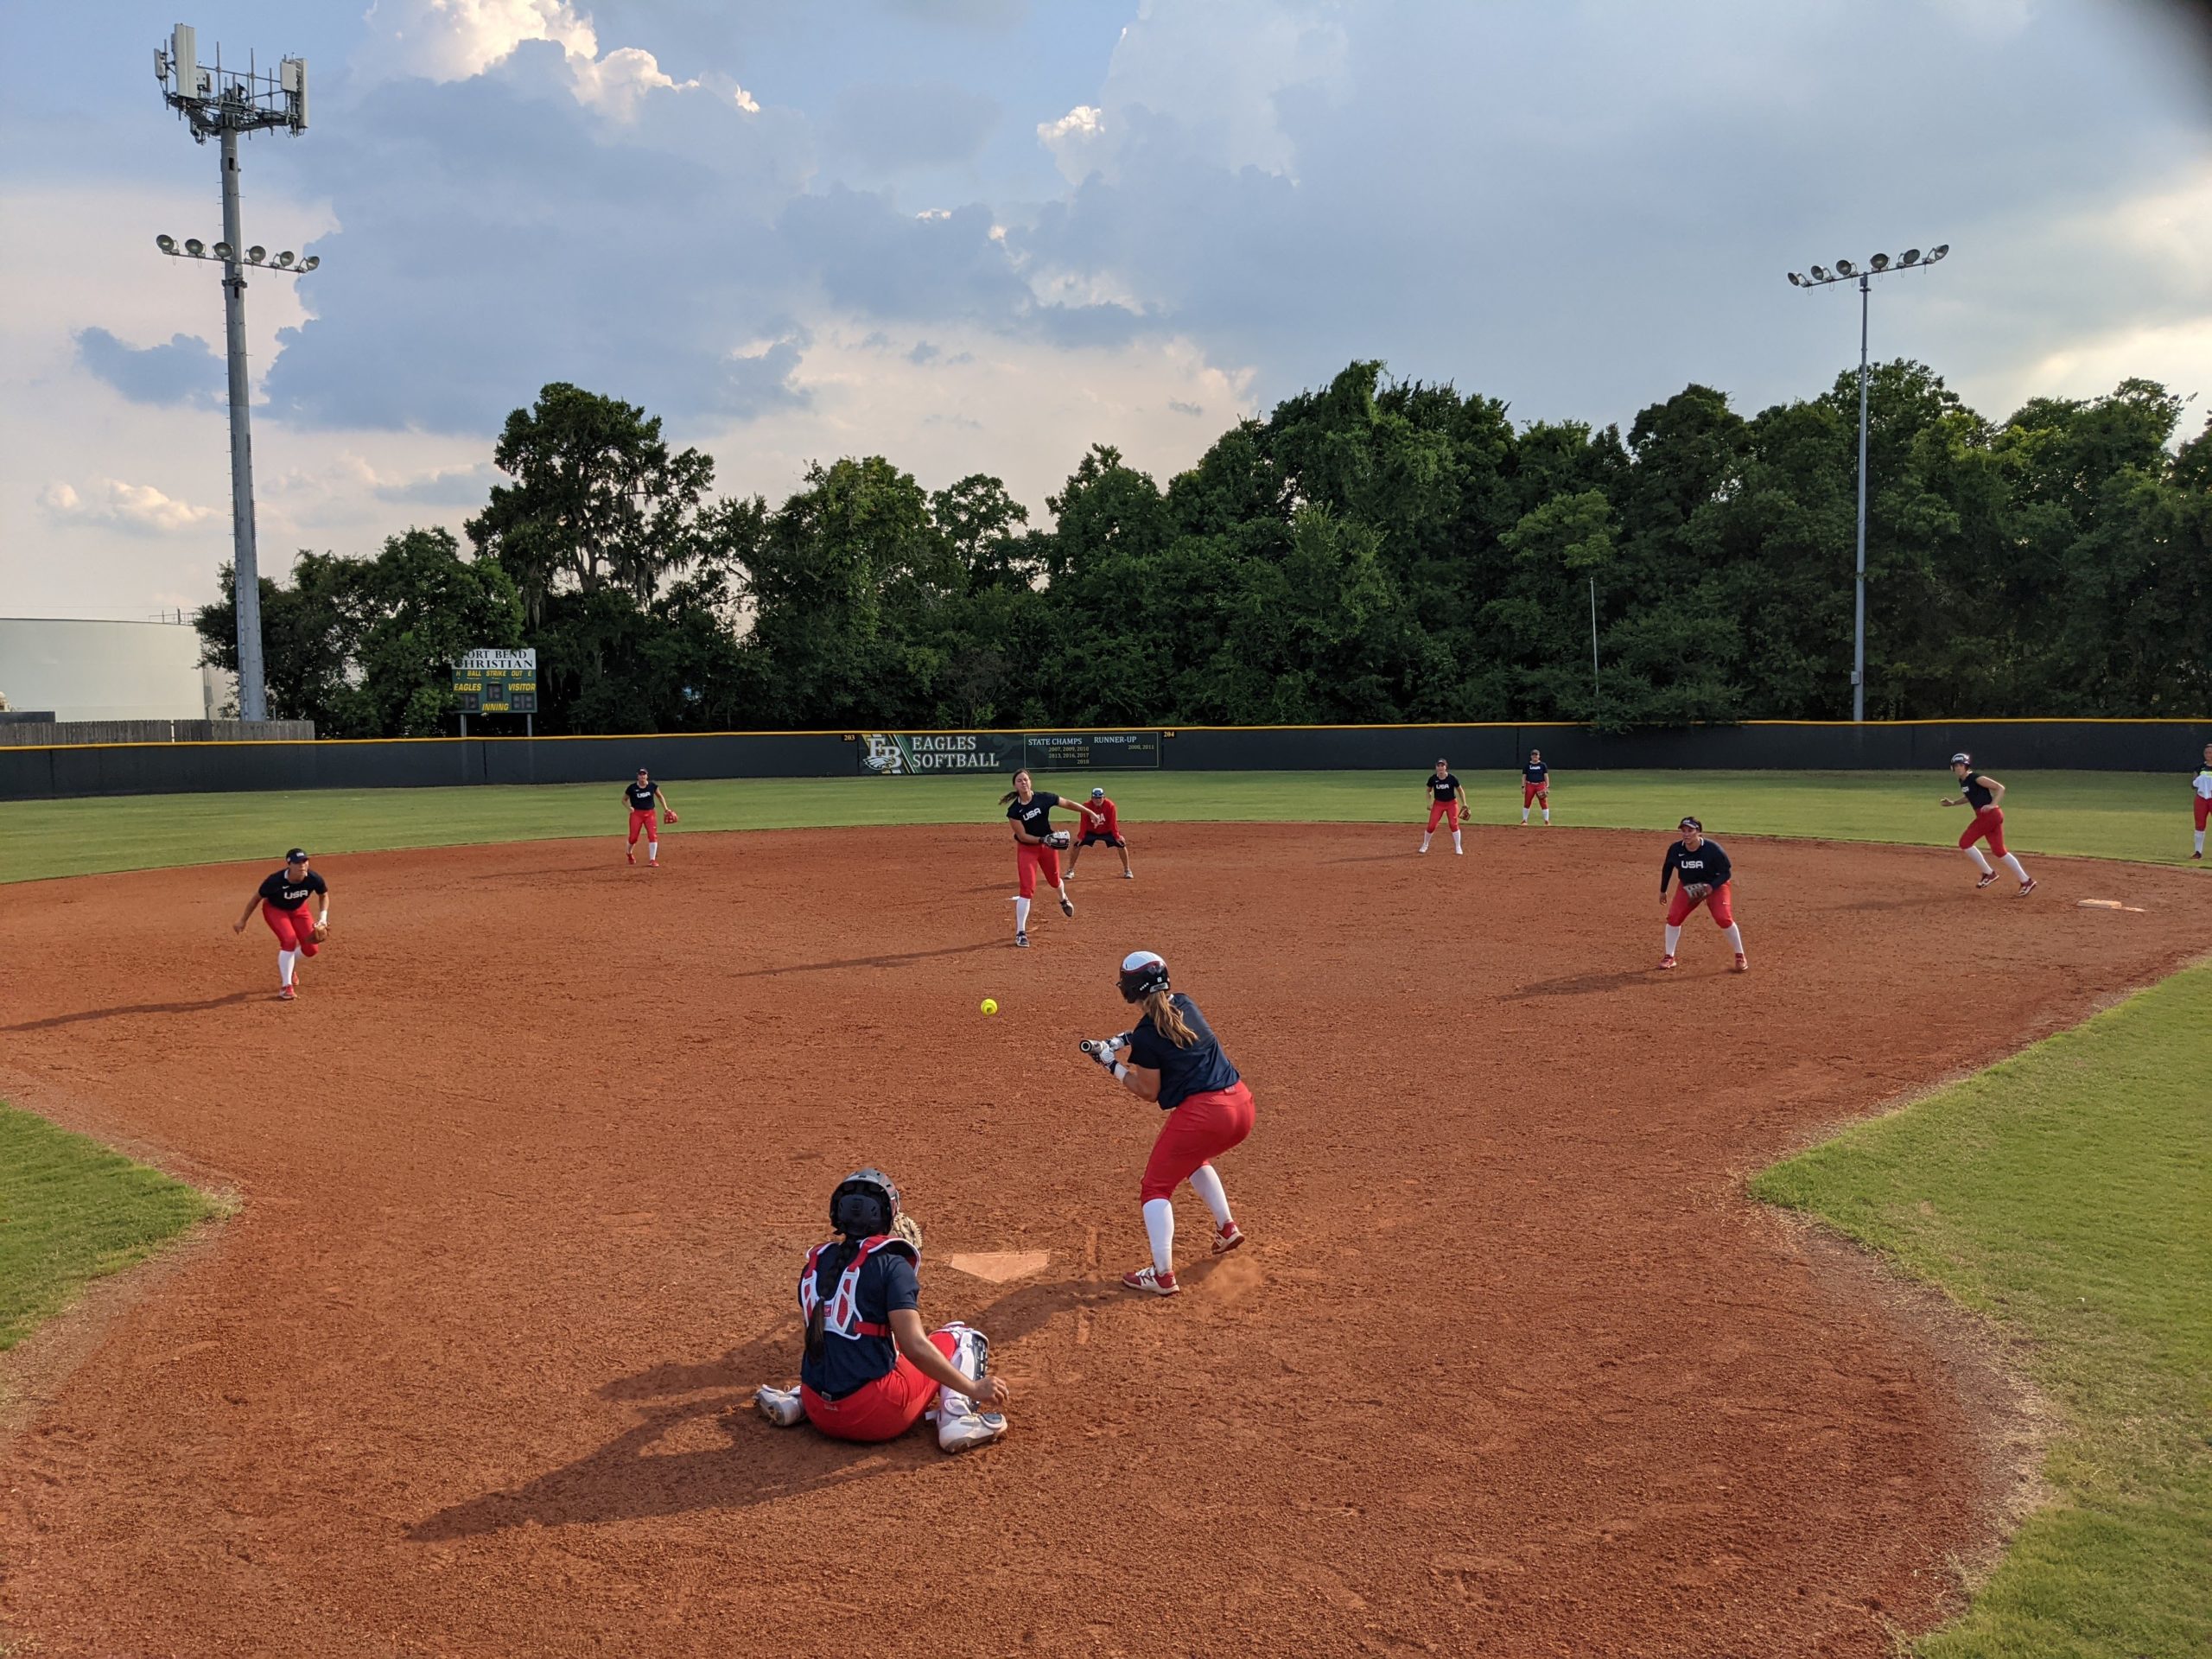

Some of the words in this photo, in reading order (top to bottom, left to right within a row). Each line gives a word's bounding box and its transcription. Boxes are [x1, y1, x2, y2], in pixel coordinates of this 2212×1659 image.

[495, 651, 527, 659] BEND
[481, 702, 510, 711] INNING
[912, 735, 977, 751] EAGLES
[912, 752, 1001, 768] SOFTBALL
[1022, 808, 1041, 821] USA
[1681, 860, 1704, 869] USA
[283, 889, 308, 899] USA
